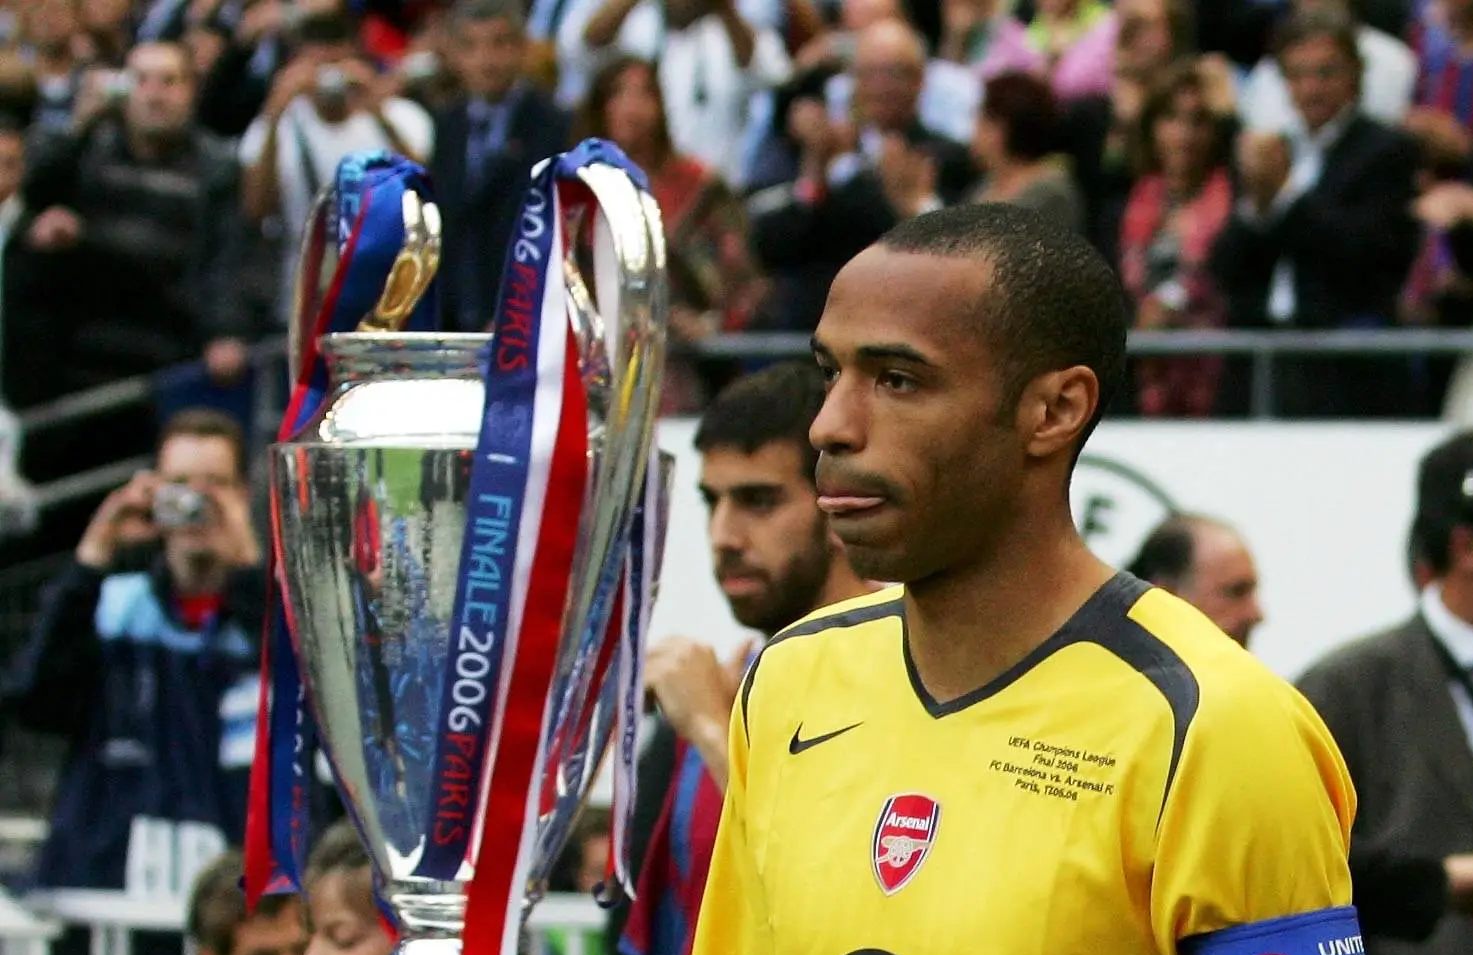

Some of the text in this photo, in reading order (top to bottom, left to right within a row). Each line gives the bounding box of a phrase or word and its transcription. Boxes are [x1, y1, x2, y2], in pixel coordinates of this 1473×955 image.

[449, 625, 495, 733] 2006
[1008, 736, 1116, 768] UEFA Champions League
[1032, 754, 1079, 773] Final 2006
[989, 760, 1002, 771] FC
[1003, 763, 1047, 780] Barcelona
[1065, 776, 1104, 793] Arsenal
[885, 811, 931, 832] Arsenal
